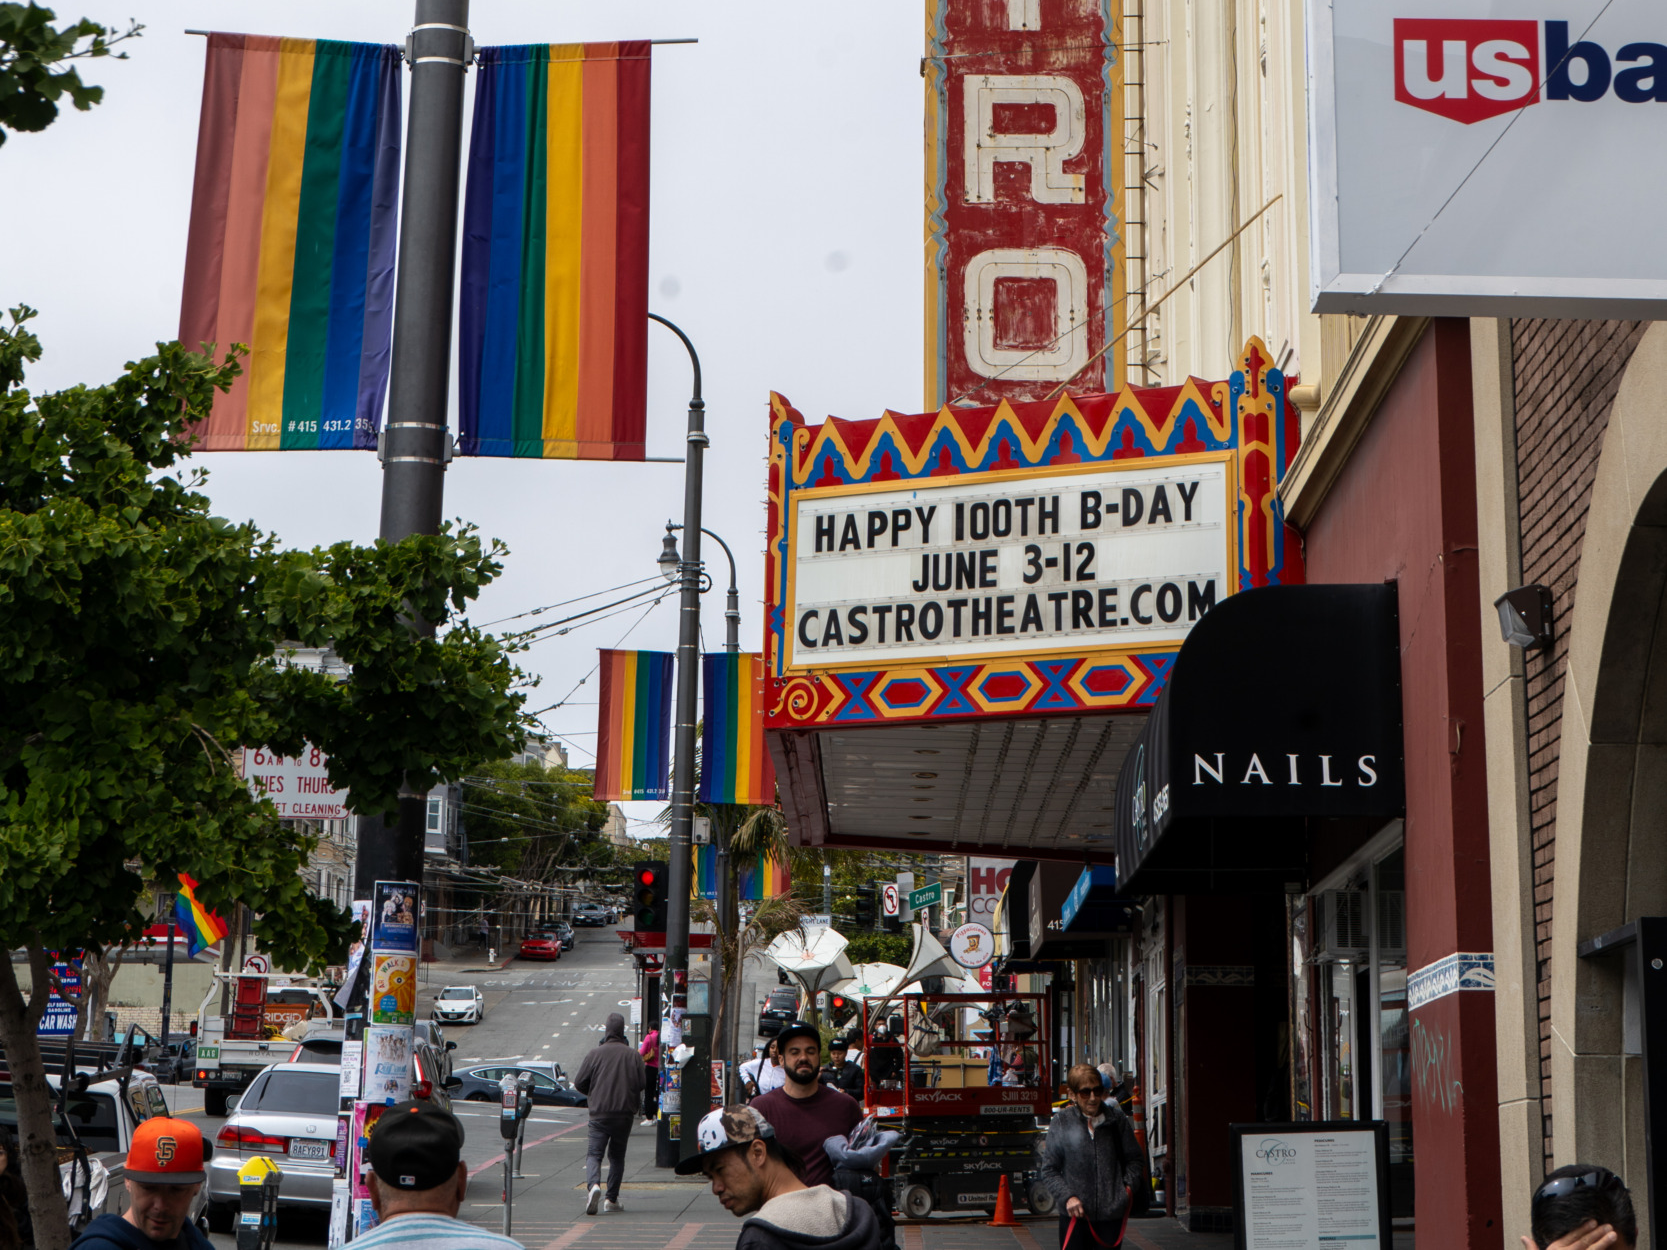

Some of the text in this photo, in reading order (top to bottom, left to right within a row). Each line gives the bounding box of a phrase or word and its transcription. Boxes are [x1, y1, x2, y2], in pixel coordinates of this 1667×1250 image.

[252, 420, 280, 433] Srvc.
[814, 504, 937, 553] HAPPY
[1080, 481, 1200, 530] B-DAY
[912, 541, 1096, 592] JUNE 3-12
[798, 579, 1216, 648] CASTROTHEATRE.COM
[1192, 752, 1378, 787] NAILS
[292, 803, 341, 815] CLEANING
[915, 892, 935, 905] Castro
[39, 1014, 78, 1030] CAR WASH
[914, 1090, 962, 1102] SKYJACK
[1020, 1091, 1038, 1101] 3219
[983, 1106, 1031, 1114] 800-UR-RENTS
[1256, 1148, 1297, 1159] CASTRO
[963, 1160, 1002, 1171] SKYJACK
